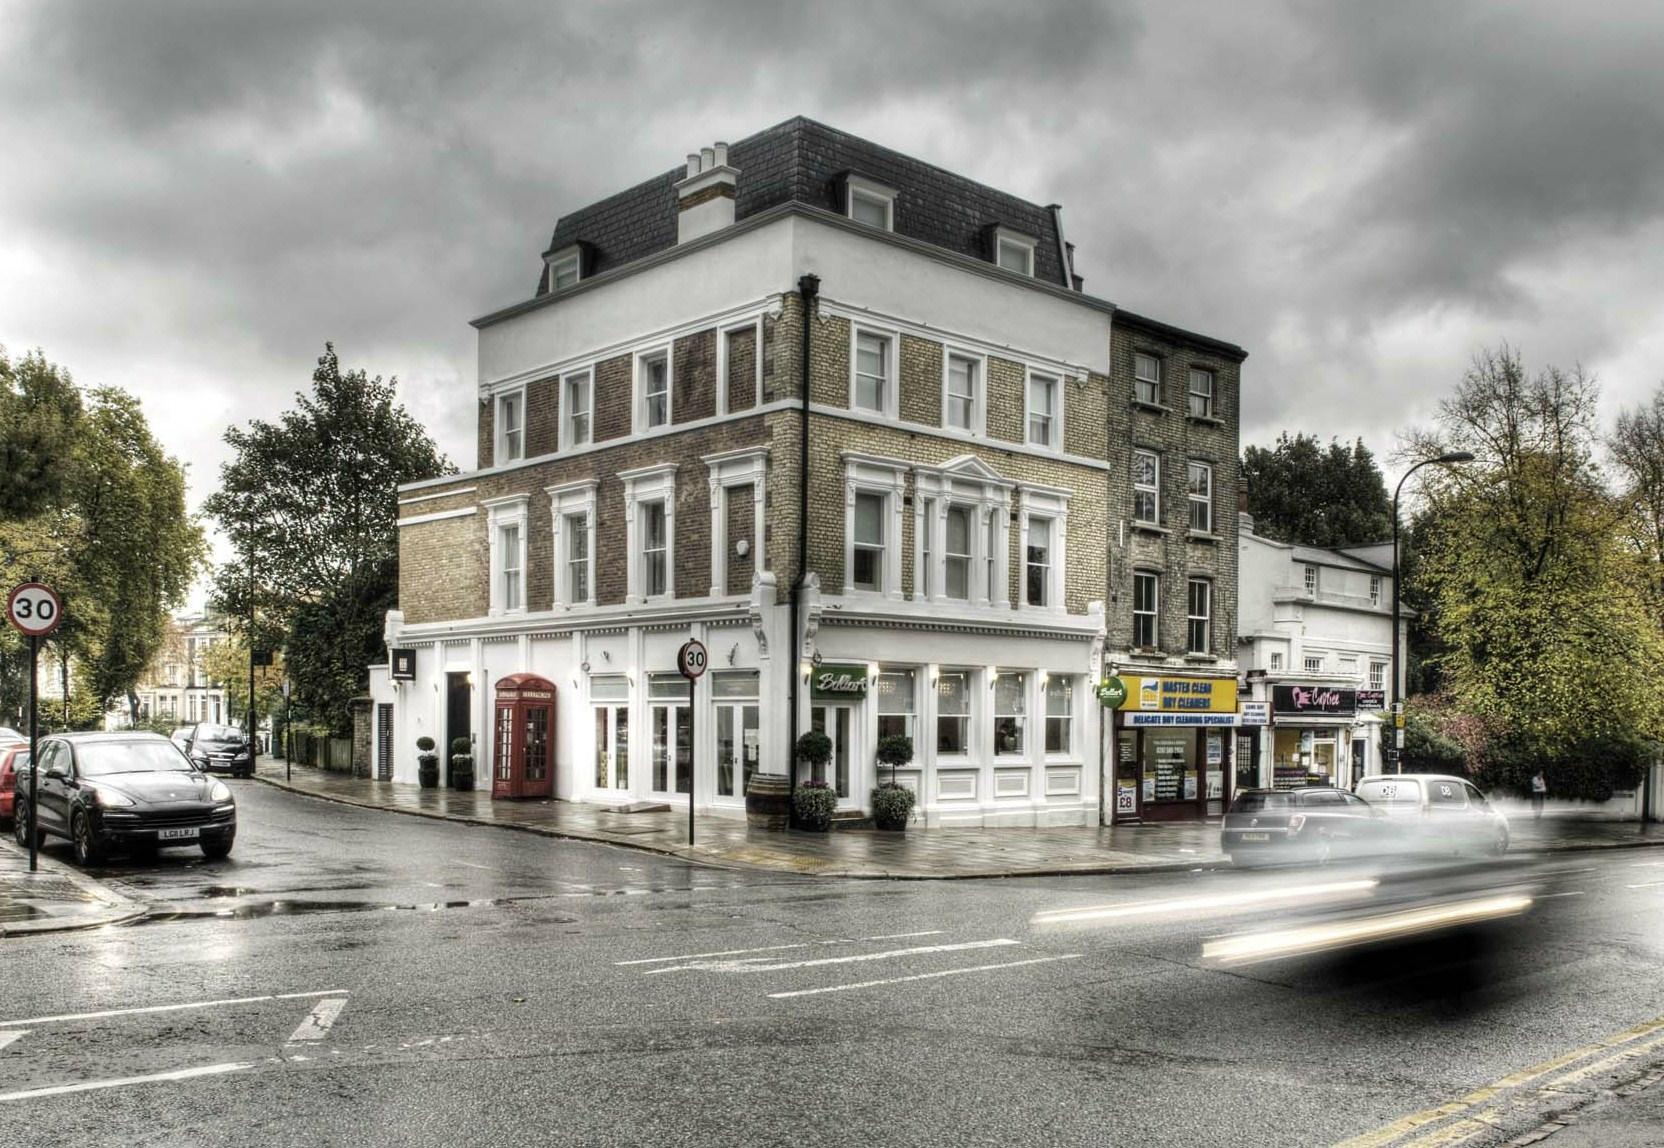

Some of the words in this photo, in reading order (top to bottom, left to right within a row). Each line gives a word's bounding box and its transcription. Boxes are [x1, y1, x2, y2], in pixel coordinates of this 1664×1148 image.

[16, 597, 54, 620] 30
[687, 651, 705, 667] 30
[1162, 681, 1190, 693] MASTER
[1191, 682, 1212, 694] CLEAN
[1162, 697, 1177, 708] DRY
[1133, 715, 1161, 724] DELICATE
[1176, 715, 1203, 725] CLEANING
[1204, 716, 1234, 725] SPECIALIST
[1119, 796, 1132, 809] £8
